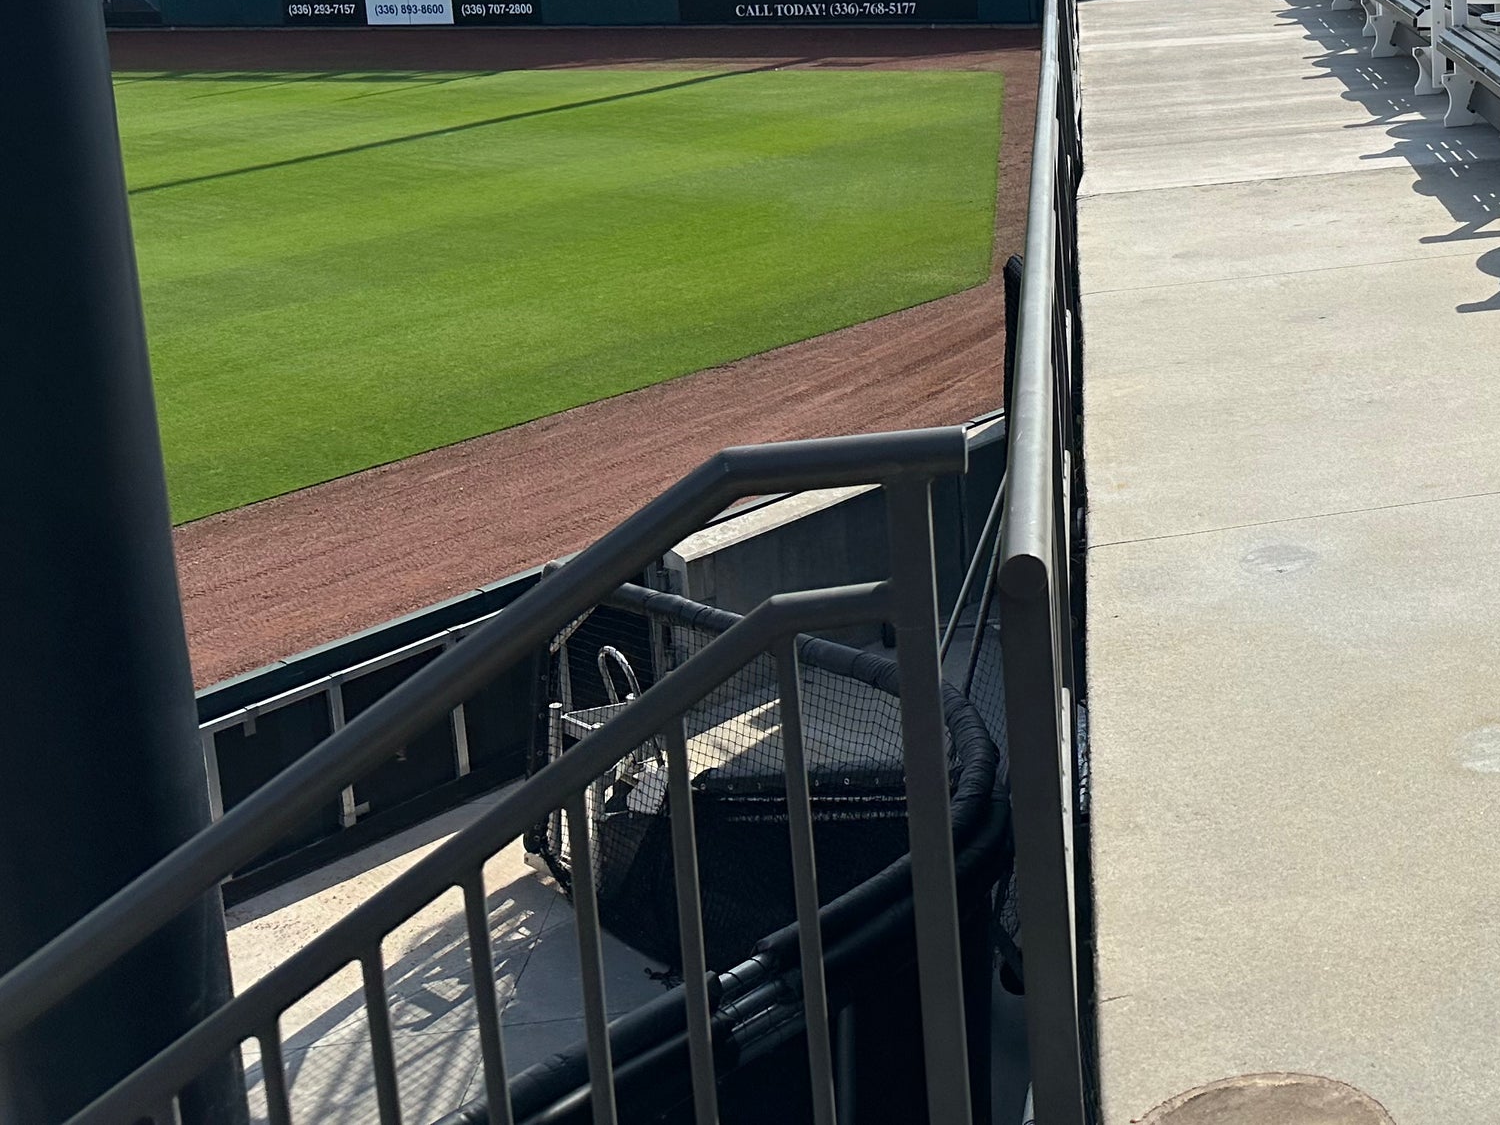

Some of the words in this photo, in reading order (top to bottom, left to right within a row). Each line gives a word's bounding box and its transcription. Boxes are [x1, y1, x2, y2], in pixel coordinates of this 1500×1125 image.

[289, 4, 312, 16] (336)
[314, 4, 355, 14] 293-7157
[375, 4, 398, 16] (336)
[401, 3, 444, 14] 893-8600
[461, 4, 486, 16] (336)
[488, 3, 532, 14] 707-2800
[736, 4, 772, 16] CALL
[774, 3, 826, 16] TODAY!
[830, 2, 916, 16] (336)-768-5177
